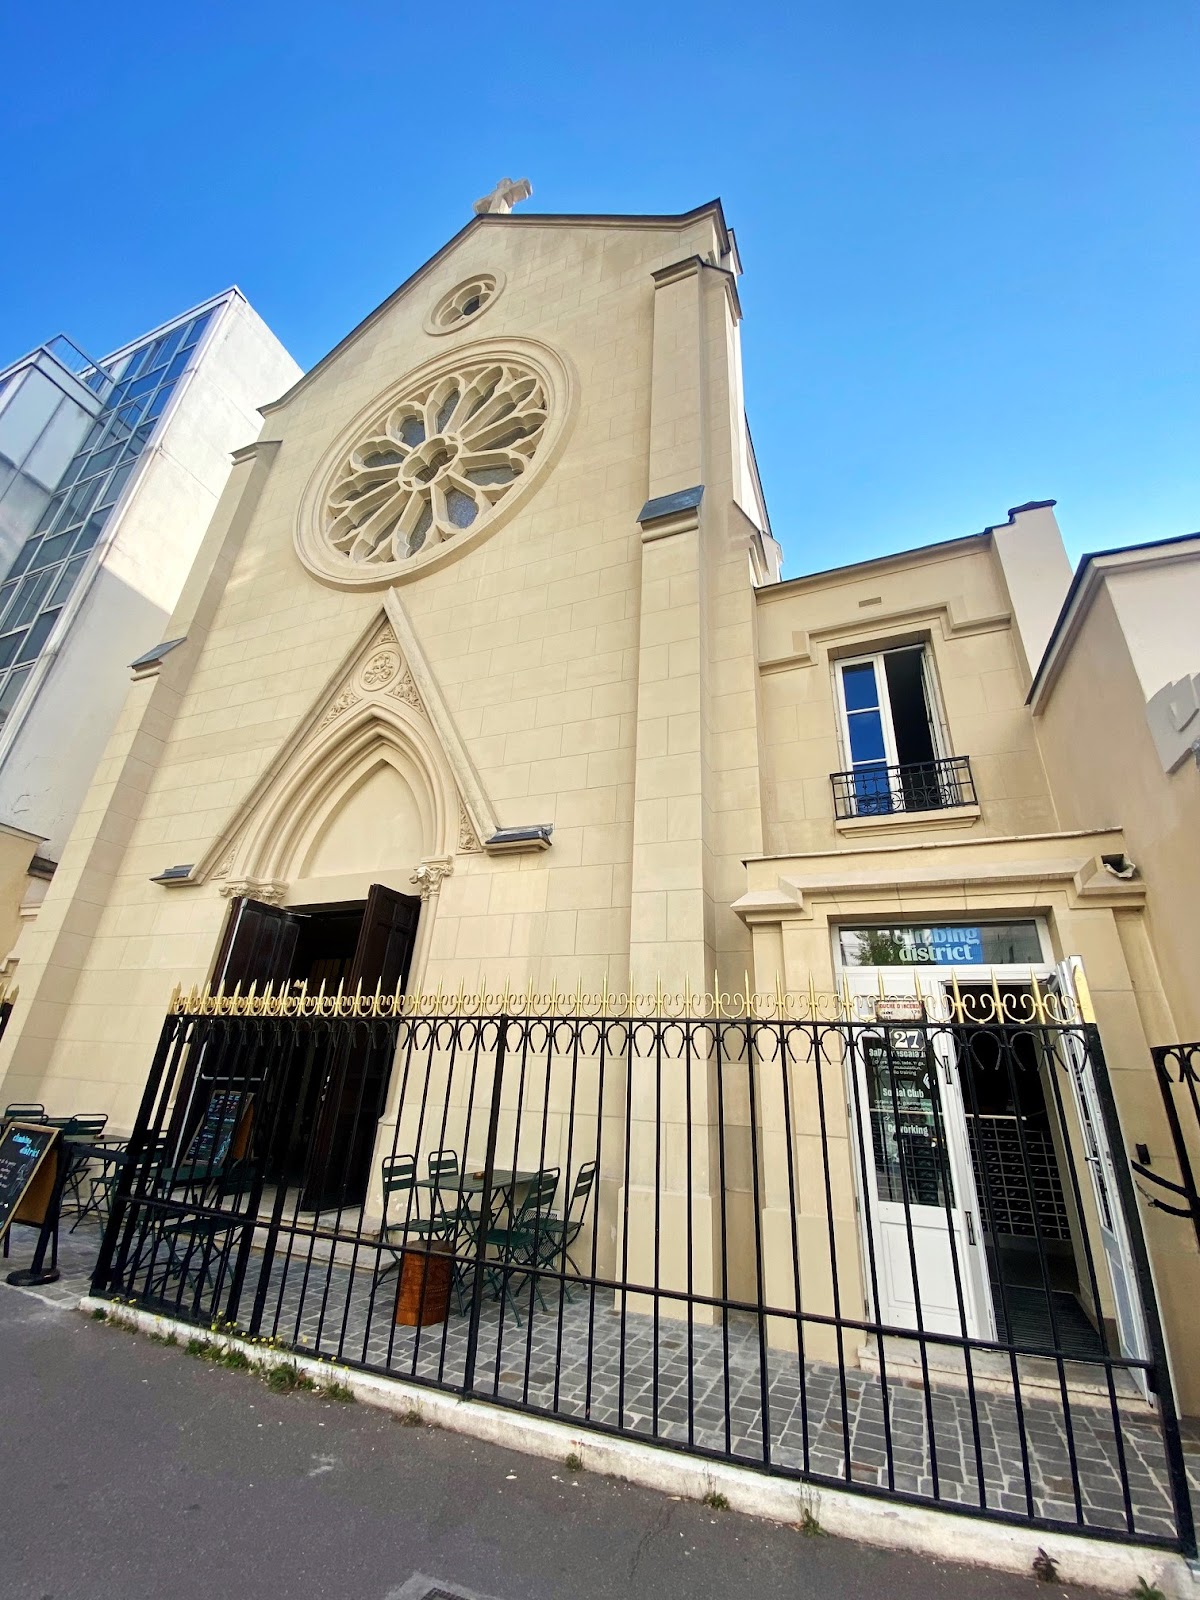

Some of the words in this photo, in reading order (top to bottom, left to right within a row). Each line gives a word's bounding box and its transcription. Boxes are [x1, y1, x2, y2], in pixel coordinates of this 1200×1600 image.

[899, 944, 974, 962] district
[893, 1030, 920, 1049] 27
[882, 1087, 906, 1097] Soial
[907, 1089, 924, 1098] Club
